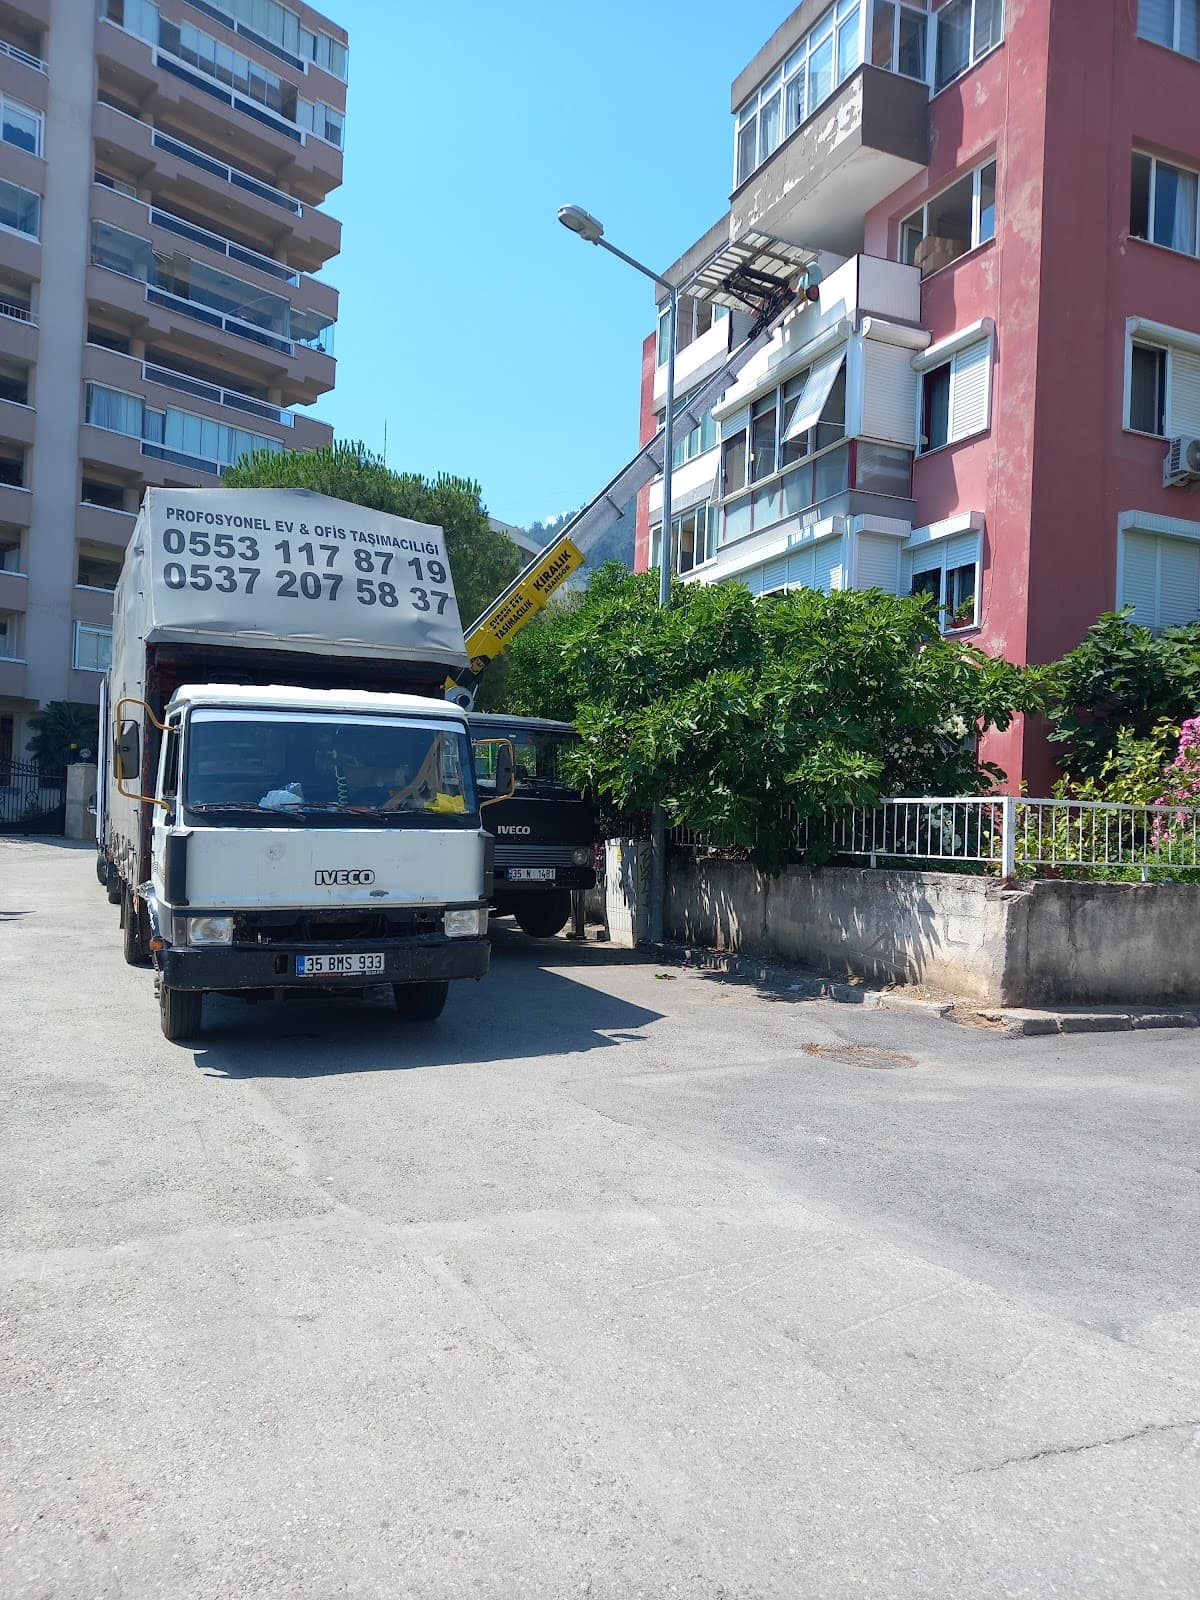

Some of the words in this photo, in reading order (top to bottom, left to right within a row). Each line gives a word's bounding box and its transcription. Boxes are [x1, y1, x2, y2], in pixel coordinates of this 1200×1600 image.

[166, 507, 271, 531] PROFOSYONEL
[275, 520, 294, 533] EV
[299, 523, 310, 535] &
[314, 525, 346, 540] OFİS
[350, 530, 439, 555] TAŞIMACILIĞI
[163, 528, 260, 561] 0553
[274, 539, 340, 568] 117
[353, 548, 394, 576] 87
[408, 557, 447, 584] 19
[533, 550, 572, 591] KİRALIK
[163, 562, 261, 594] 0537
[275, 569, 344, 601] 207
[356, 578, 399, 608] 58
[409, 587, 449, 615] 37
[497, 825, 531, 835] IVECO
[315, 870, 375, 885] IVECO
[307, 957, 323, 972] 35
[328, 956, 352, 971] BMS
[359, 955, 382, 969] 933
